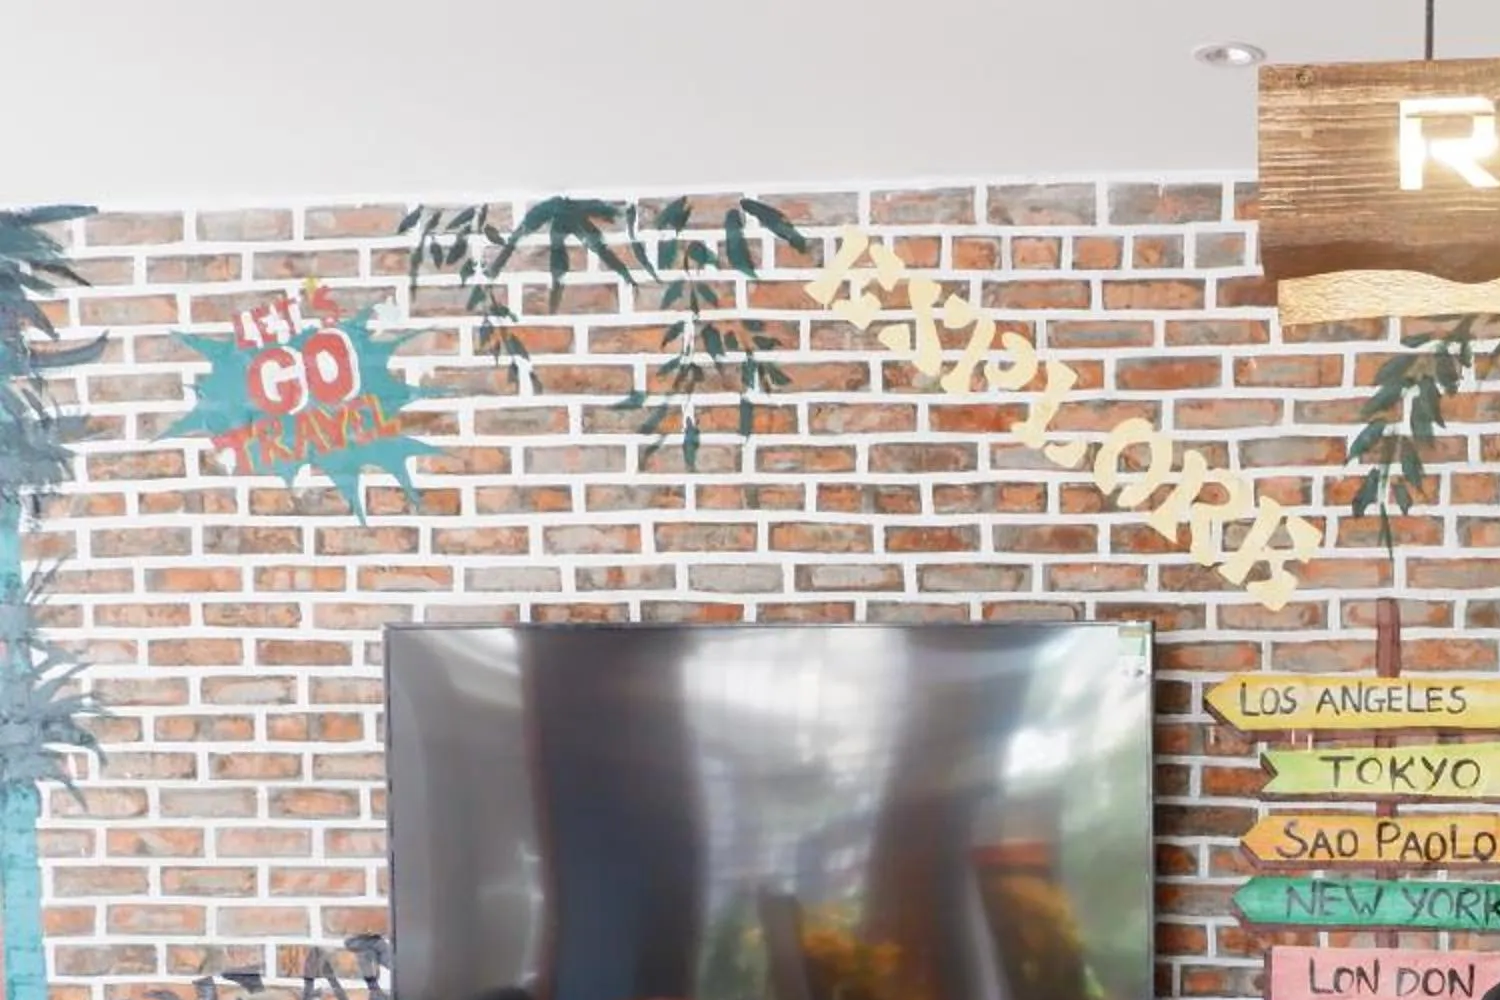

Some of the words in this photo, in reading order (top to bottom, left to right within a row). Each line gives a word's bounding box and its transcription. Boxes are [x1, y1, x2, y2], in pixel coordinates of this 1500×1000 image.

[246, 326, 361, 416] GO
[211, 393, 402, 476] TRAVEL
[806, 225, 1322, 611] EXPLORE
[1240, 682, 1297, 717] LOS
[1315, 680, 1467, 715] ANGELES
[1319, 754, 1481, 790] TOKYO
[1275, 820, 1358, 859] SAO
[1376, 821, 1497, 861] PAOLO
[1286, 880, 1384, 919] NEW
